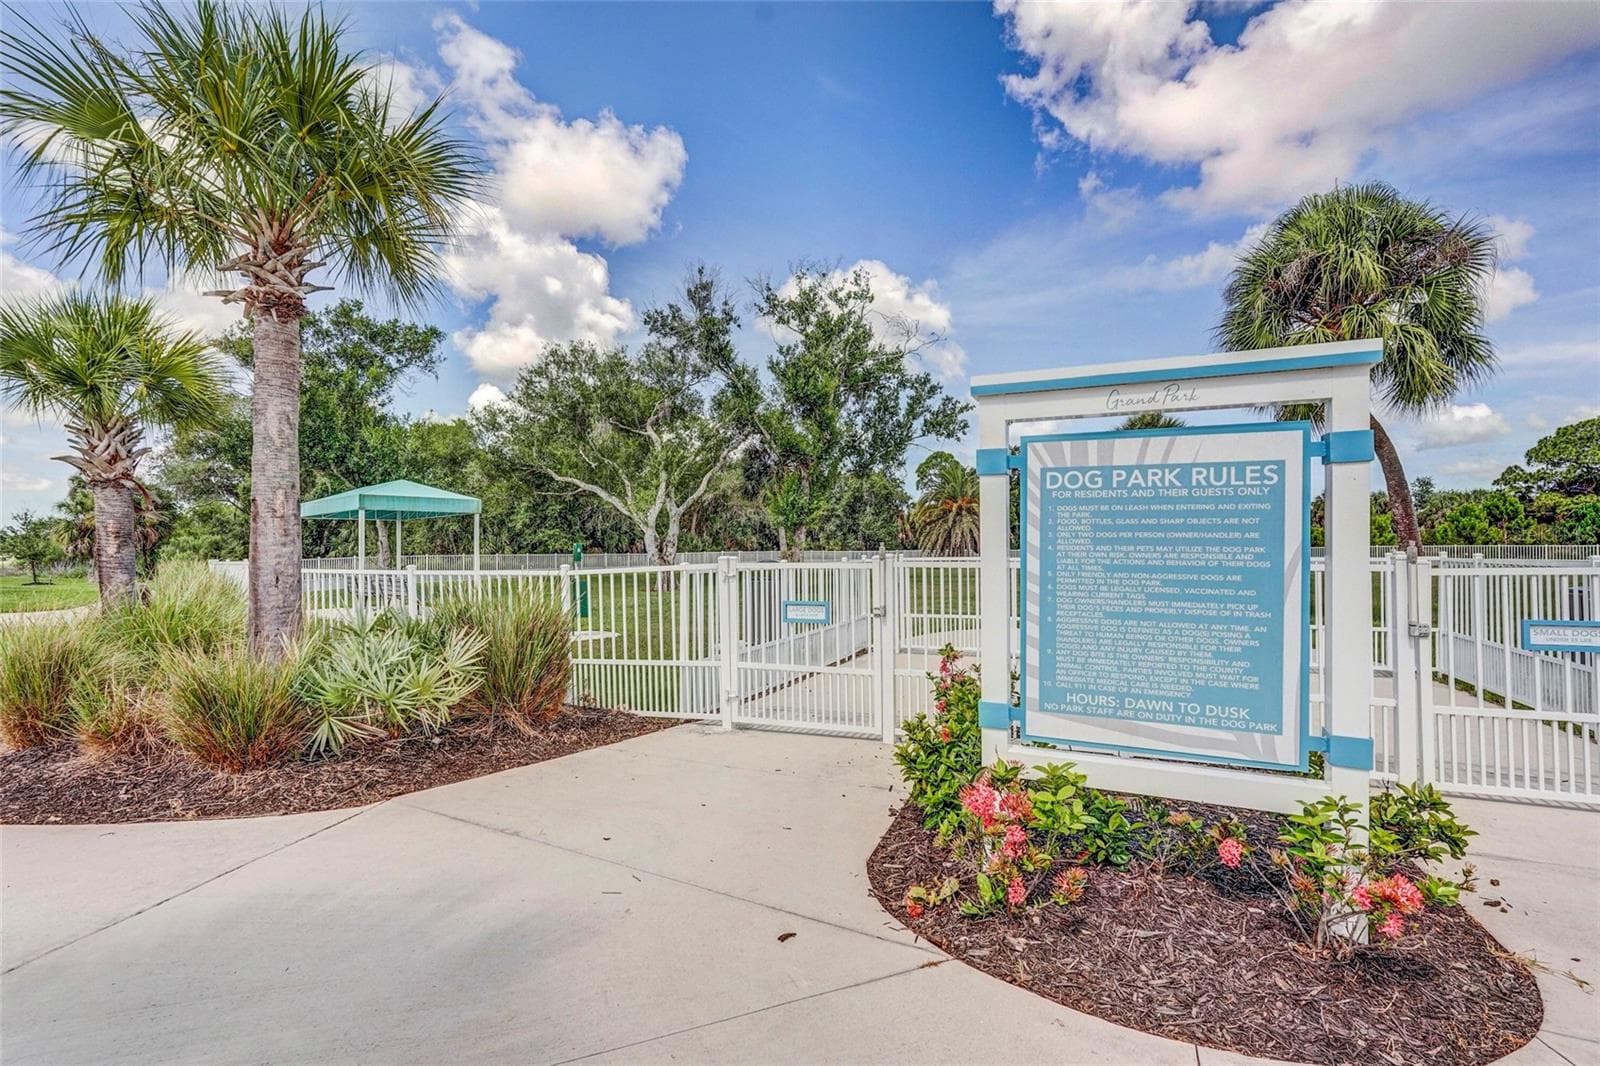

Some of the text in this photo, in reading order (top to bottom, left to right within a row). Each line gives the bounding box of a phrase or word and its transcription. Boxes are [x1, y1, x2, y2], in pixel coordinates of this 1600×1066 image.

[1106, 383, 1199, 410] Grand Park
[1046, 465, 1279, 489] DOG PARK RULES
[1052, 486, 1270, 498] FOR RESIDENTS AND THEIR GUESTS ONLY
[1533, 628, 1568, 636] SMALL
[1060, 704, 1083, 713] PARK
[1086, 706, 1113, 716] STAFF
[1116, 709, 1135, 718] ARE
[1137, 711, 1153, 719] ON
[1155, 713, 1181, 722] DUTY
[1184, 715, 1195, 723] IN
[1199, 717, 1217, 725] THE
[1221, 719, 1245, 728] DOG
[1248, 721, 1277, 731] PARK
[1066, 692, 1250, 719] HOURS: DAWN TO DUSK
